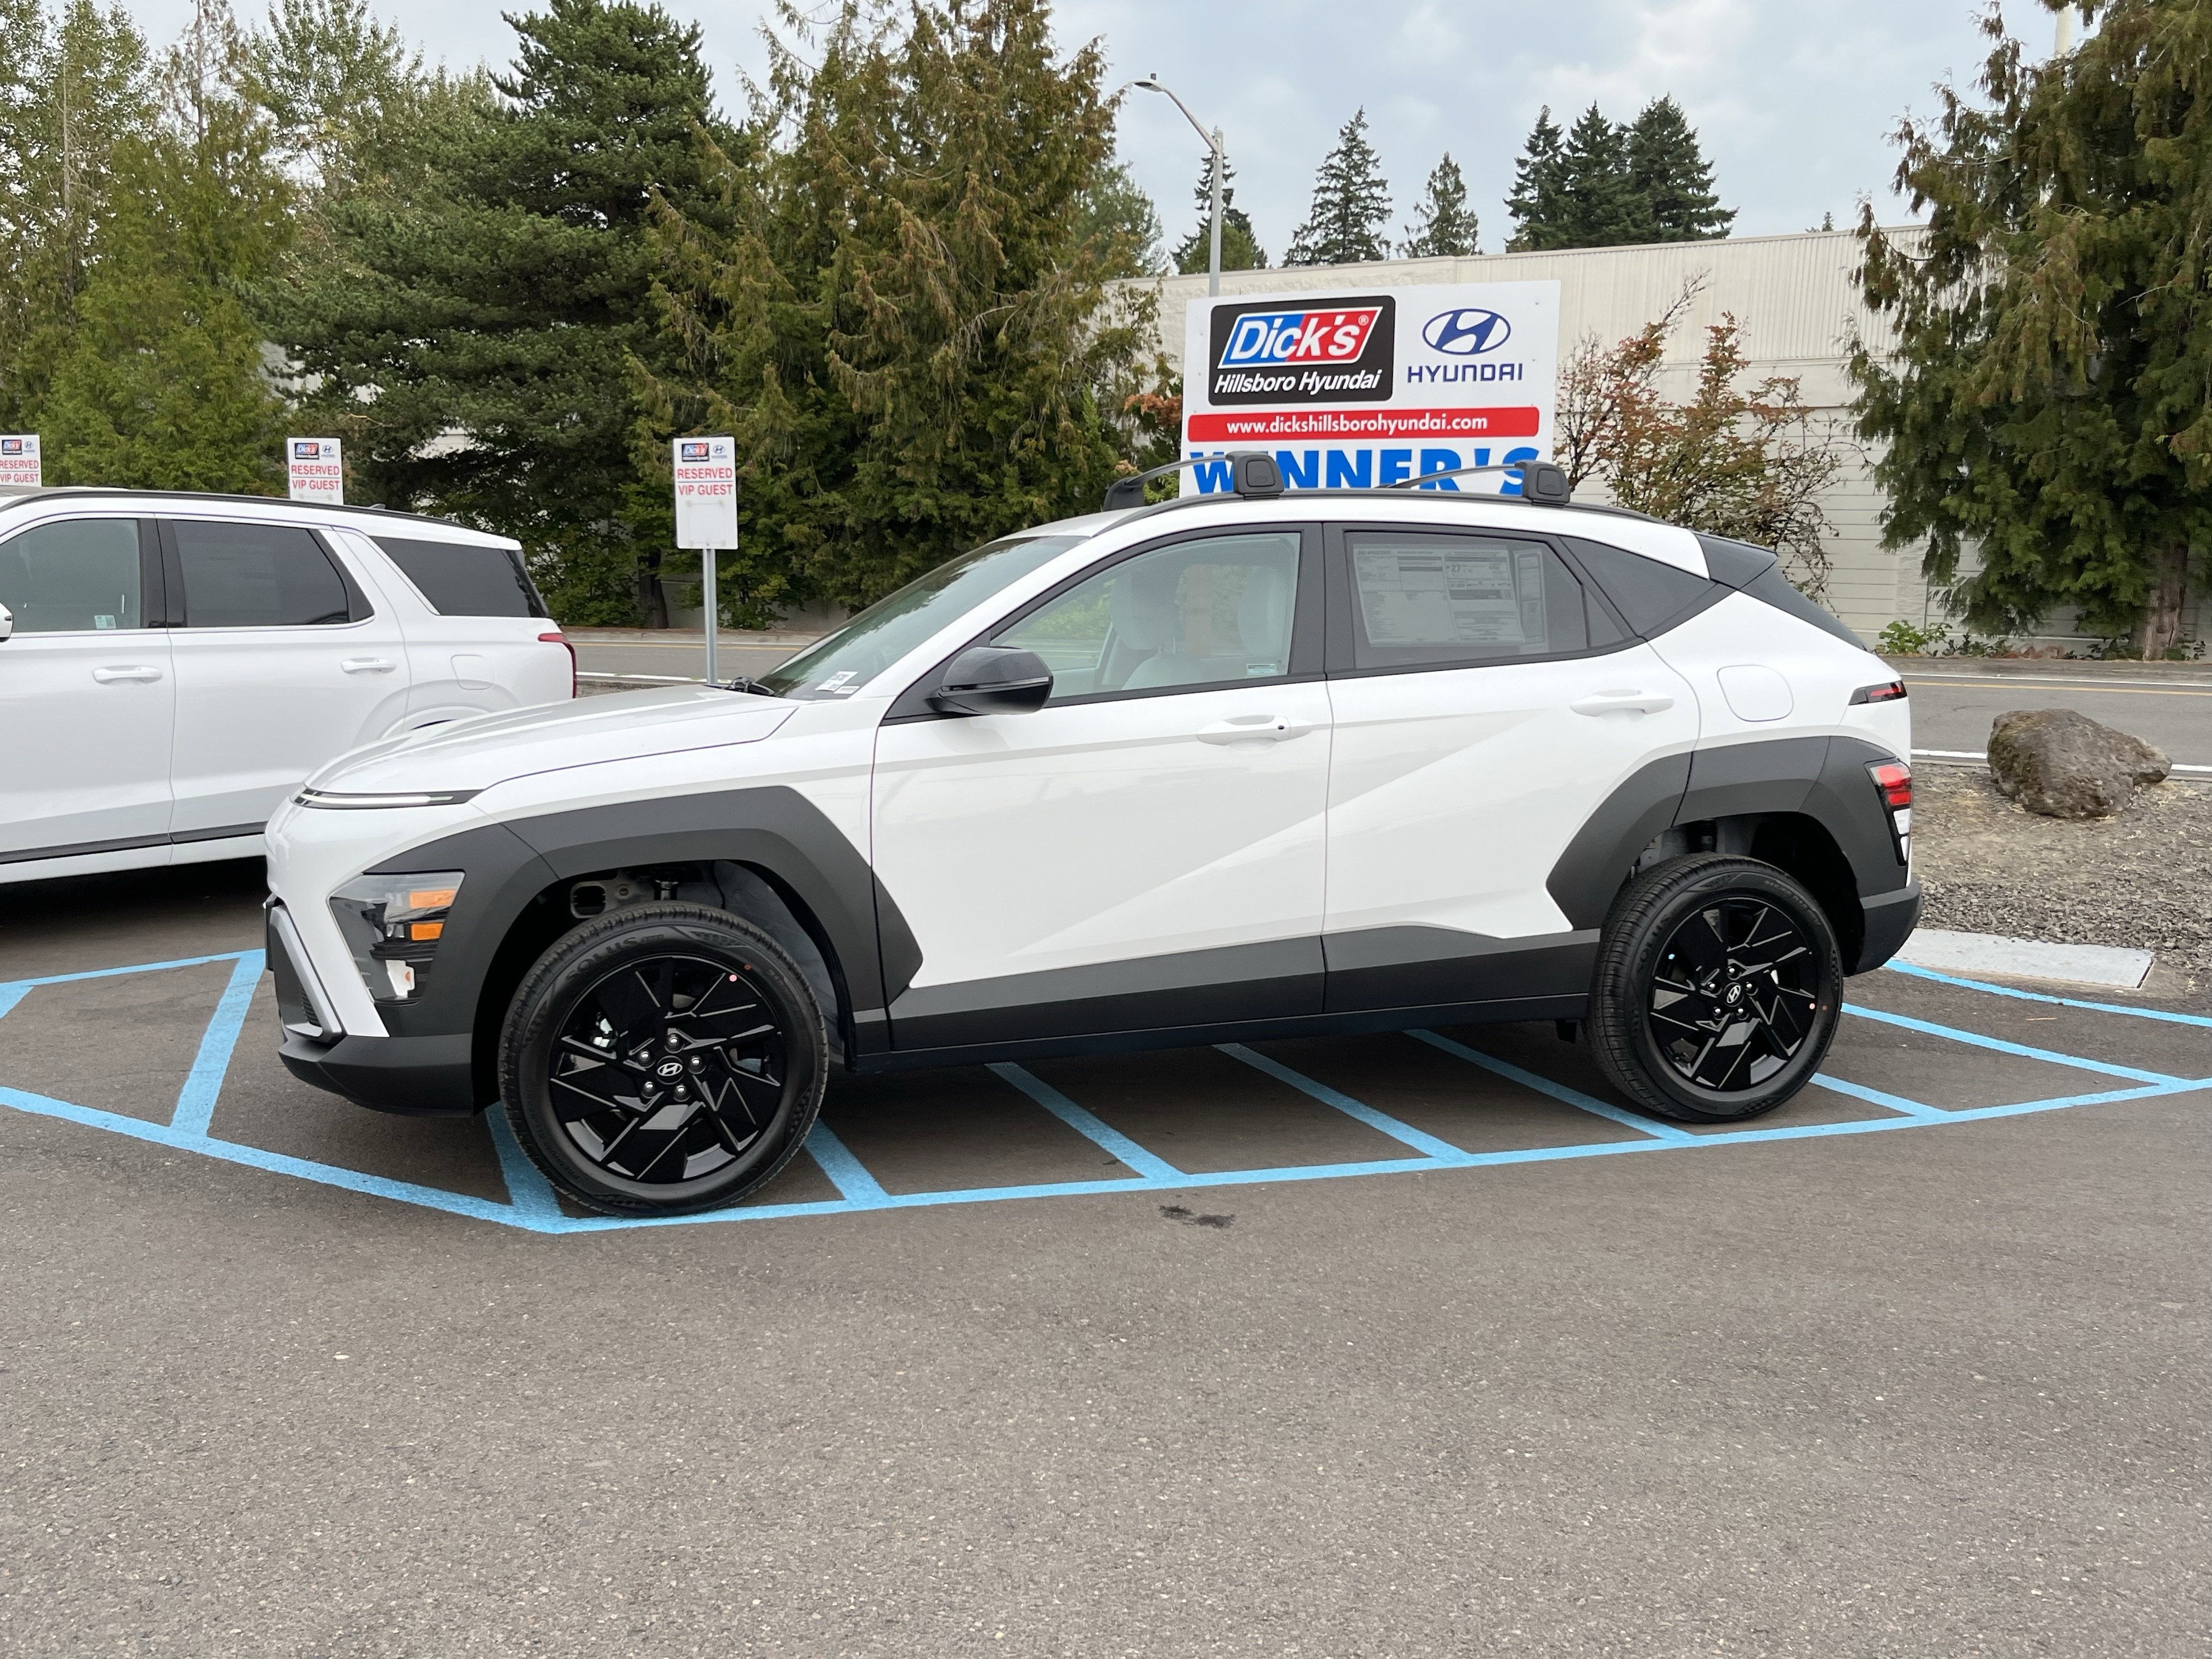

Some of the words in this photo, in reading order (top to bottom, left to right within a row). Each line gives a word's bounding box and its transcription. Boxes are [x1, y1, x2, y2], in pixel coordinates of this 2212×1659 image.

[1230, 314, 1360, 360] Dick's
[1408, 363, 1523, 383] HYUNDAI
[1214, 373, 1296, 393] Hillsboro
[1298, 369, 1383, 396] Hyundai
[1227, 413, 1488, 436] www.dickshillsborohyundai.com
[0, 460, 39, 469] RESERVED
[291, 465, 340, 475] RESERVED
[677, 467, 733, 479] RESERVED
[1189, 447, 1539, 496] WNNER'S
[0, 473, 12, 482] VIP
[14, 473, 39, 483] GUEST
[292, 479, 307, 489] VIP
[309, 479, 340, 490] GUEST
[678, 485, 695, 496] VIP
[697, 484, 733, 495] GUEST
